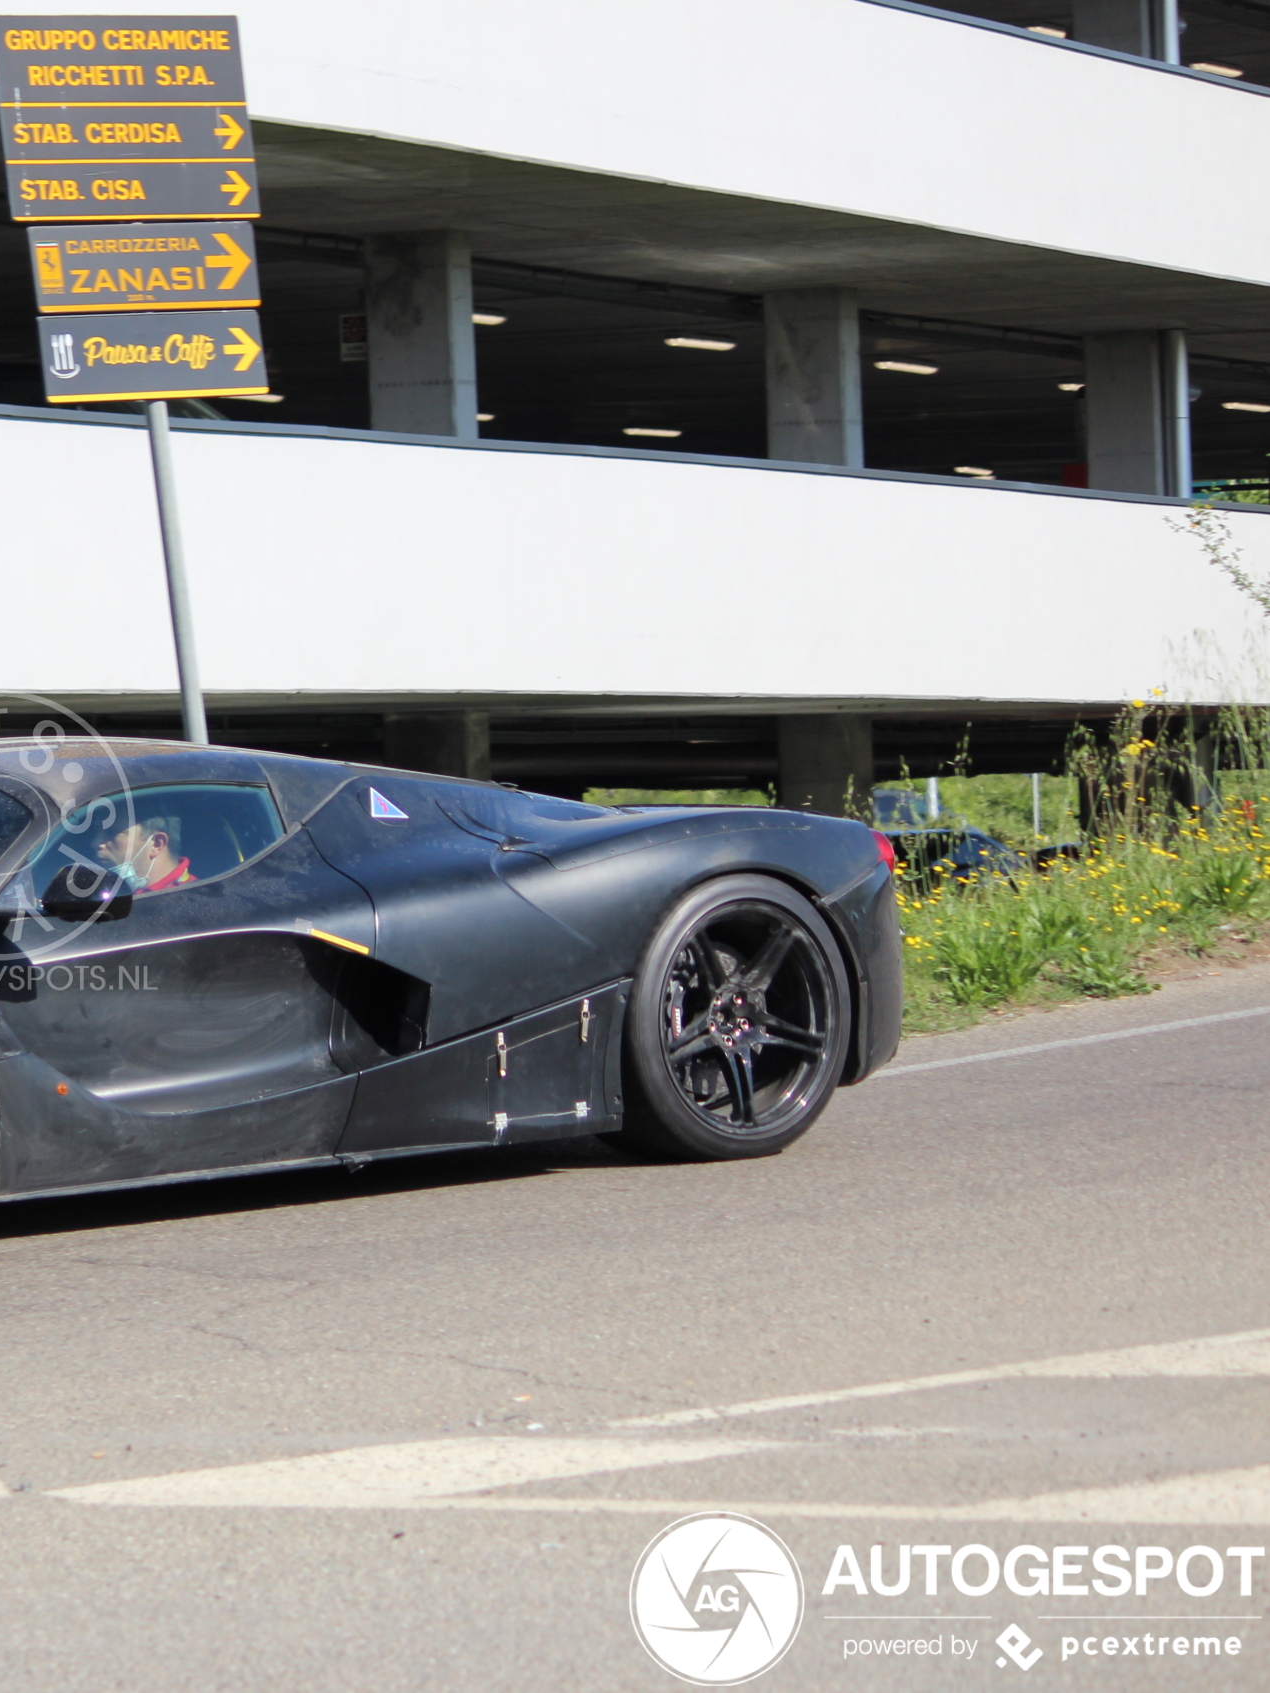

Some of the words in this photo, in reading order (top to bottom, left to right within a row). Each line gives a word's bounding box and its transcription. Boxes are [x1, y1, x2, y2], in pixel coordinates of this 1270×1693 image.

[5, 30, 96, 50] GRUPPO
[102, 30, 231, 50] CERAMICHE
[28, 65, 144, 86] RICCHETTI
[155, 65, 215, 86] S.P.A.
[14, 123, 79, 144] STAB.
[85, 123, 182, 143] CERDISA
[20, 180, 86, 200] STAB.
[91, 180, 146, 200] CISA
[65, 237, 201, 254] CARROZZERIA
[69, 266, 206, 293] ZANASI
[83, 336, 149, 367] Pausa
